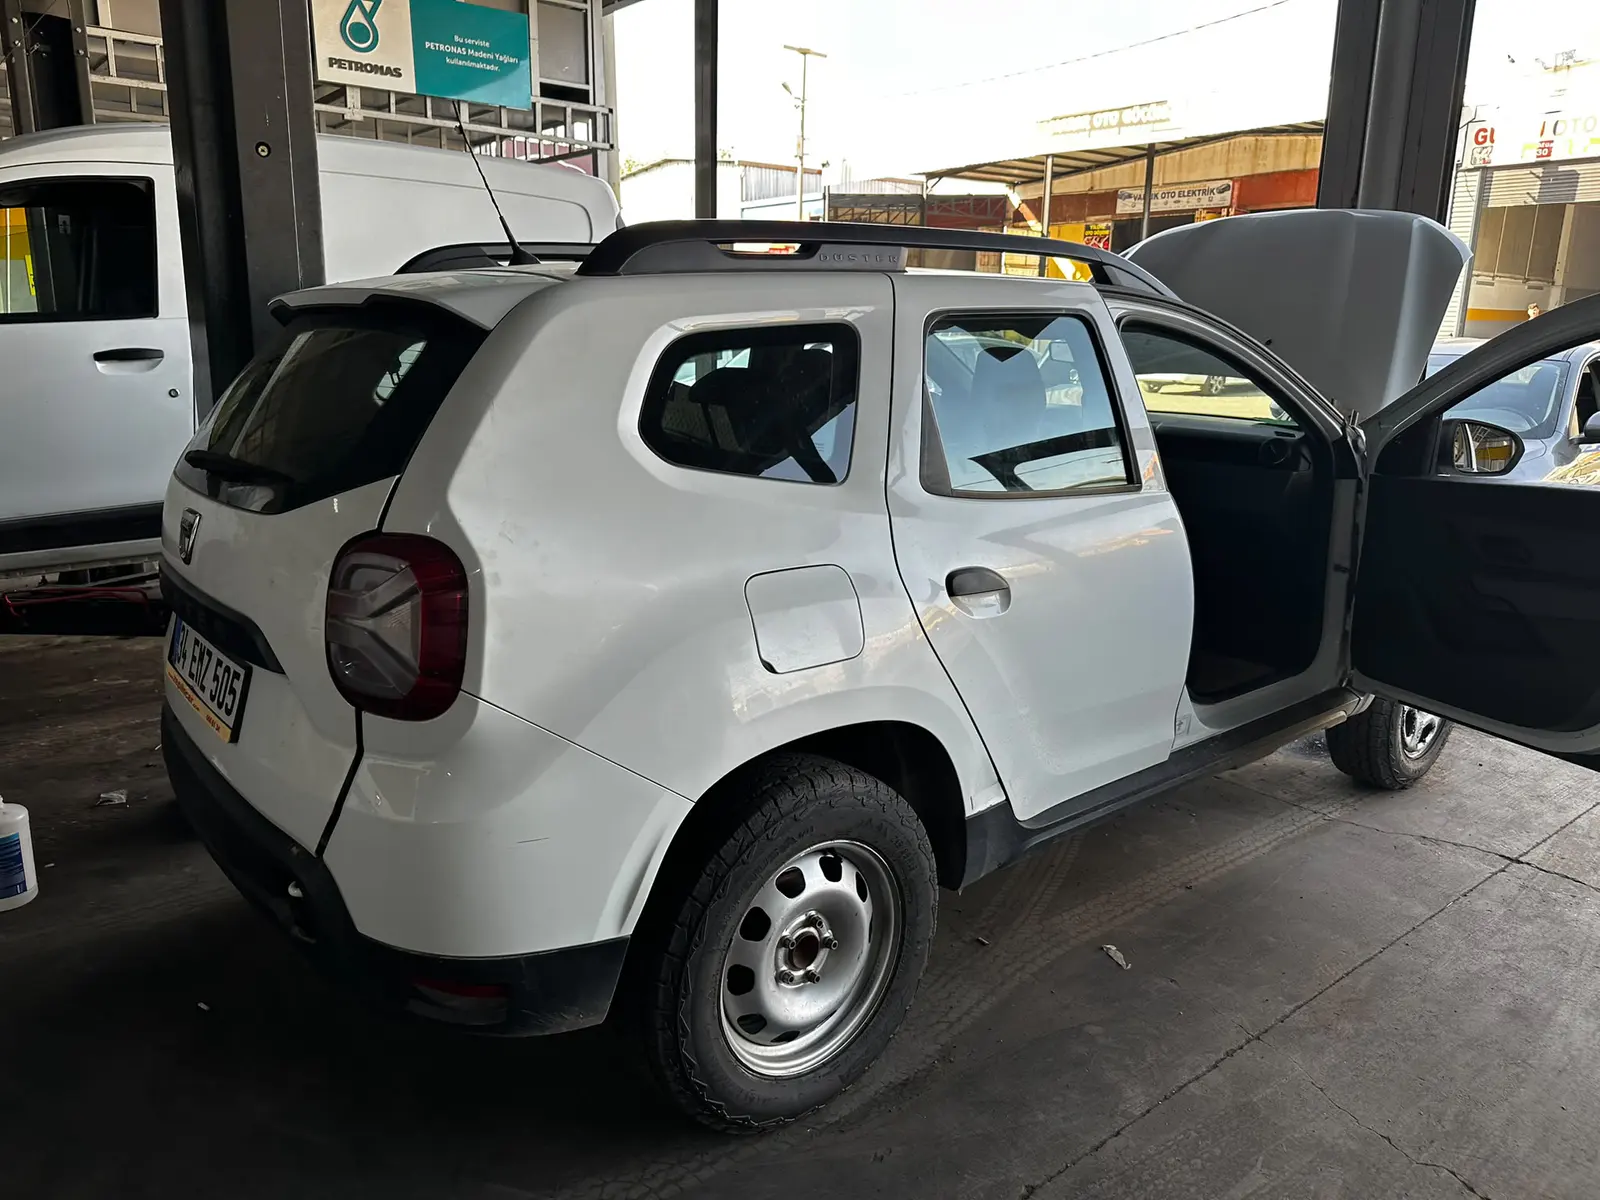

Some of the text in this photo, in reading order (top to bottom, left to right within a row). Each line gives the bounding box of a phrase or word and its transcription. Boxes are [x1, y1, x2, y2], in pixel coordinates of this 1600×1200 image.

[454, 35, 490, 48] Bu serviste
[425, 41, 519, 65] PETRONAS Madeni Yağları
[328, 57, 403, 78] PETRONAS
[445, 56, 501, 72] kullanılmaktadır.
[1160, 191, 1176, 199] OTO
[1178, 187, 1215, 198] ELEKTRİK
[820, 253, 899, 263] DUSTER
[188, 637, 212, 694] EMZ
[210, 658, 241, 717] 505
